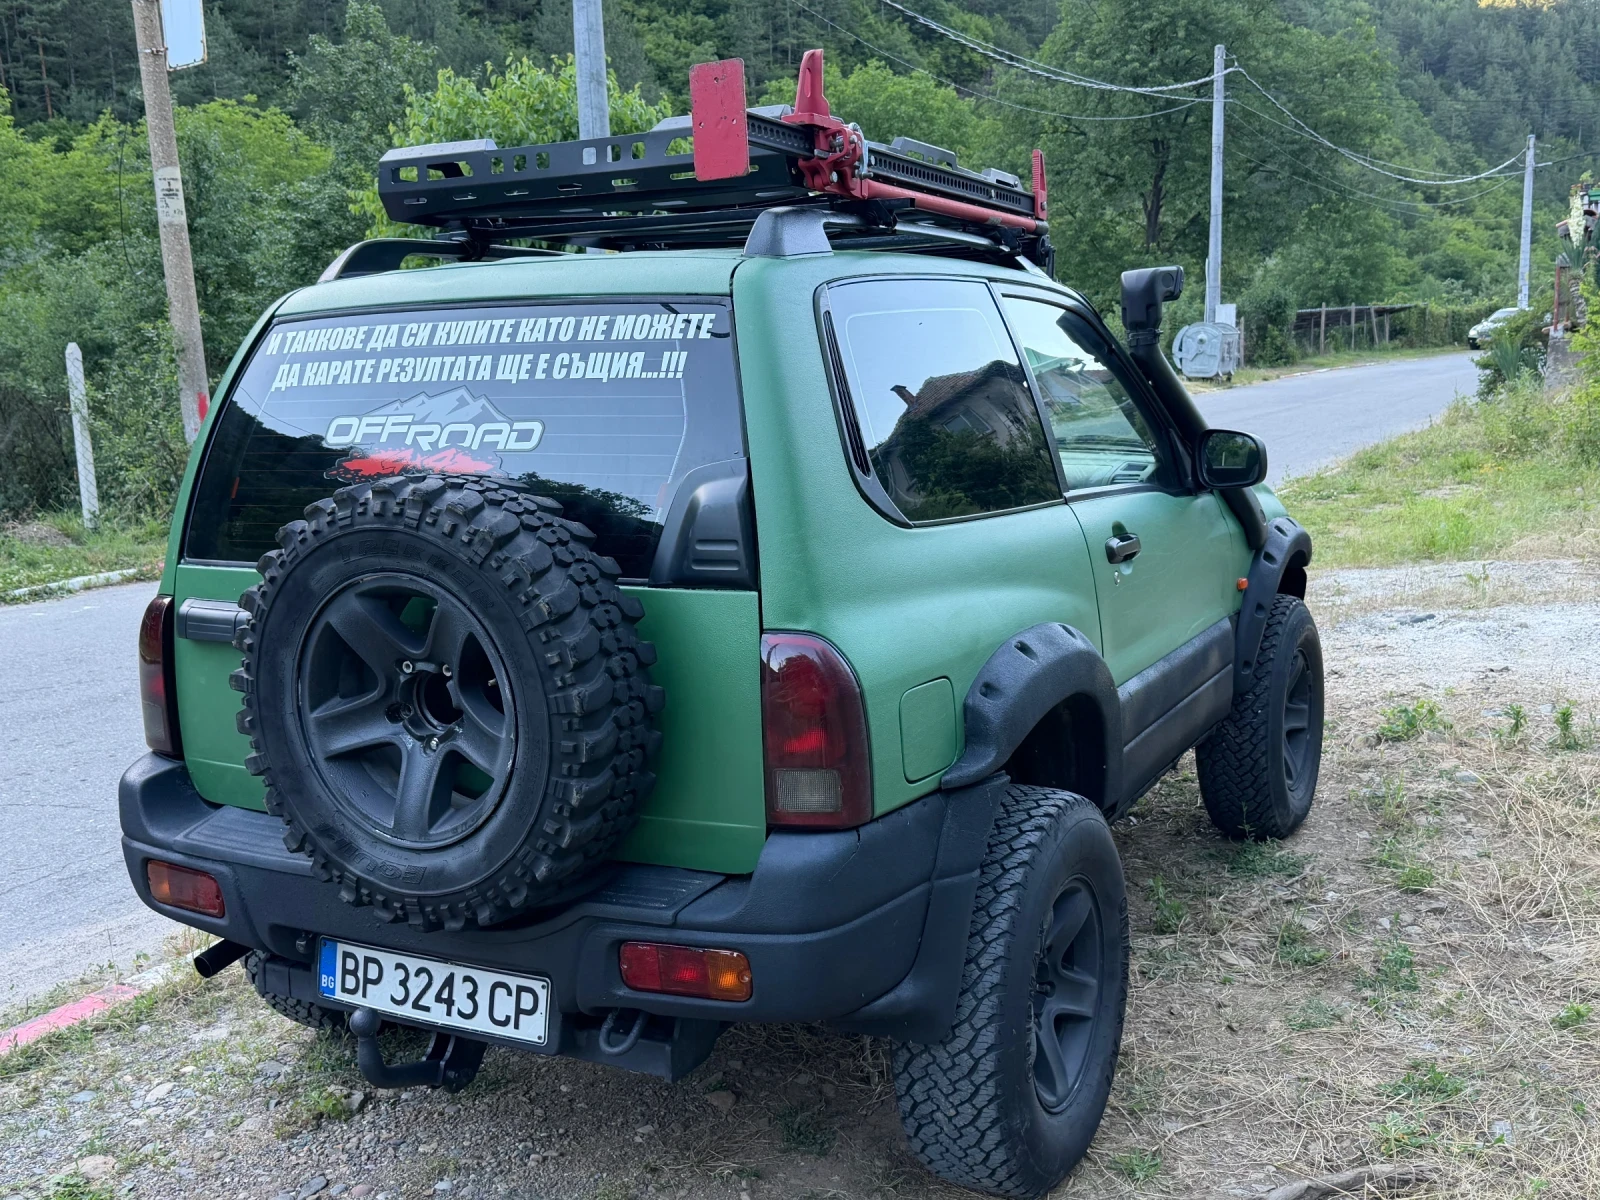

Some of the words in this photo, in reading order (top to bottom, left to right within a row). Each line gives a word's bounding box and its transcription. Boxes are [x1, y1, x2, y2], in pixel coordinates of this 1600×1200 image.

[265, 333, 284, 355] И
[283, 325, 368, 354] ТАНКОВЕ
[365, 324, 400, 352] ДА
[401, 321, 435, 347] СИ
[432, 318, 516, 346] КУПИТЕ
[515, 316, 576, 343] КАТО
[577, 315, 611, 341] НЕ
[610, 313, 716, 340] МОЖЕТЕ
[271, 363, 301, 392] ДА
[301, 358, 377, 387] КАРАТЕ
[375, 354, 493, 383] РЕЗУЛТАТА
[495, 353, 534, 384] ЩЕ
[534, 353, 551, 380] Е
[321, 974, 335, 989] BG
[340, 950, 384, 998] BP
[390, 962, 479, 1020] 3243
[488, 980, 539, 1030] CP
